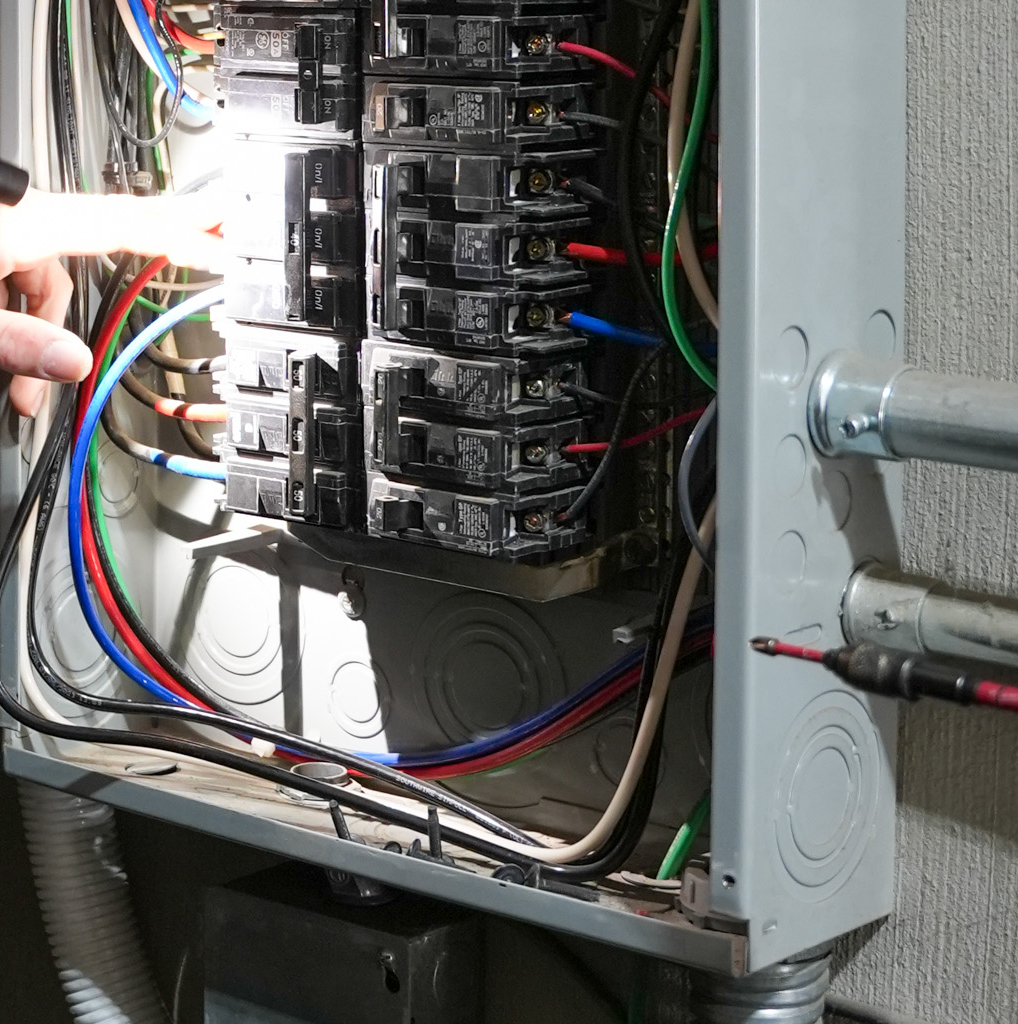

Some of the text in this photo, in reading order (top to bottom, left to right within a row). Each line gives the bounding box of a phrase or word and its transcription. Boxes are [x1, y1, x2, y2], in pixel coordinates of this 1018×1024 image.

[282, 31, 290, 51] OFF
[324, 35, 332, 49] ON
[324, 99, 333, 114] ON
[376, 103, 383, 116] 20
[290, 232, 300, 247] 40
[292, 368, 301, 381] 50
[293, 429, 303, 442] 50
[293, 489, 304, 503] 50
[375, 507, 382, 520] 20
